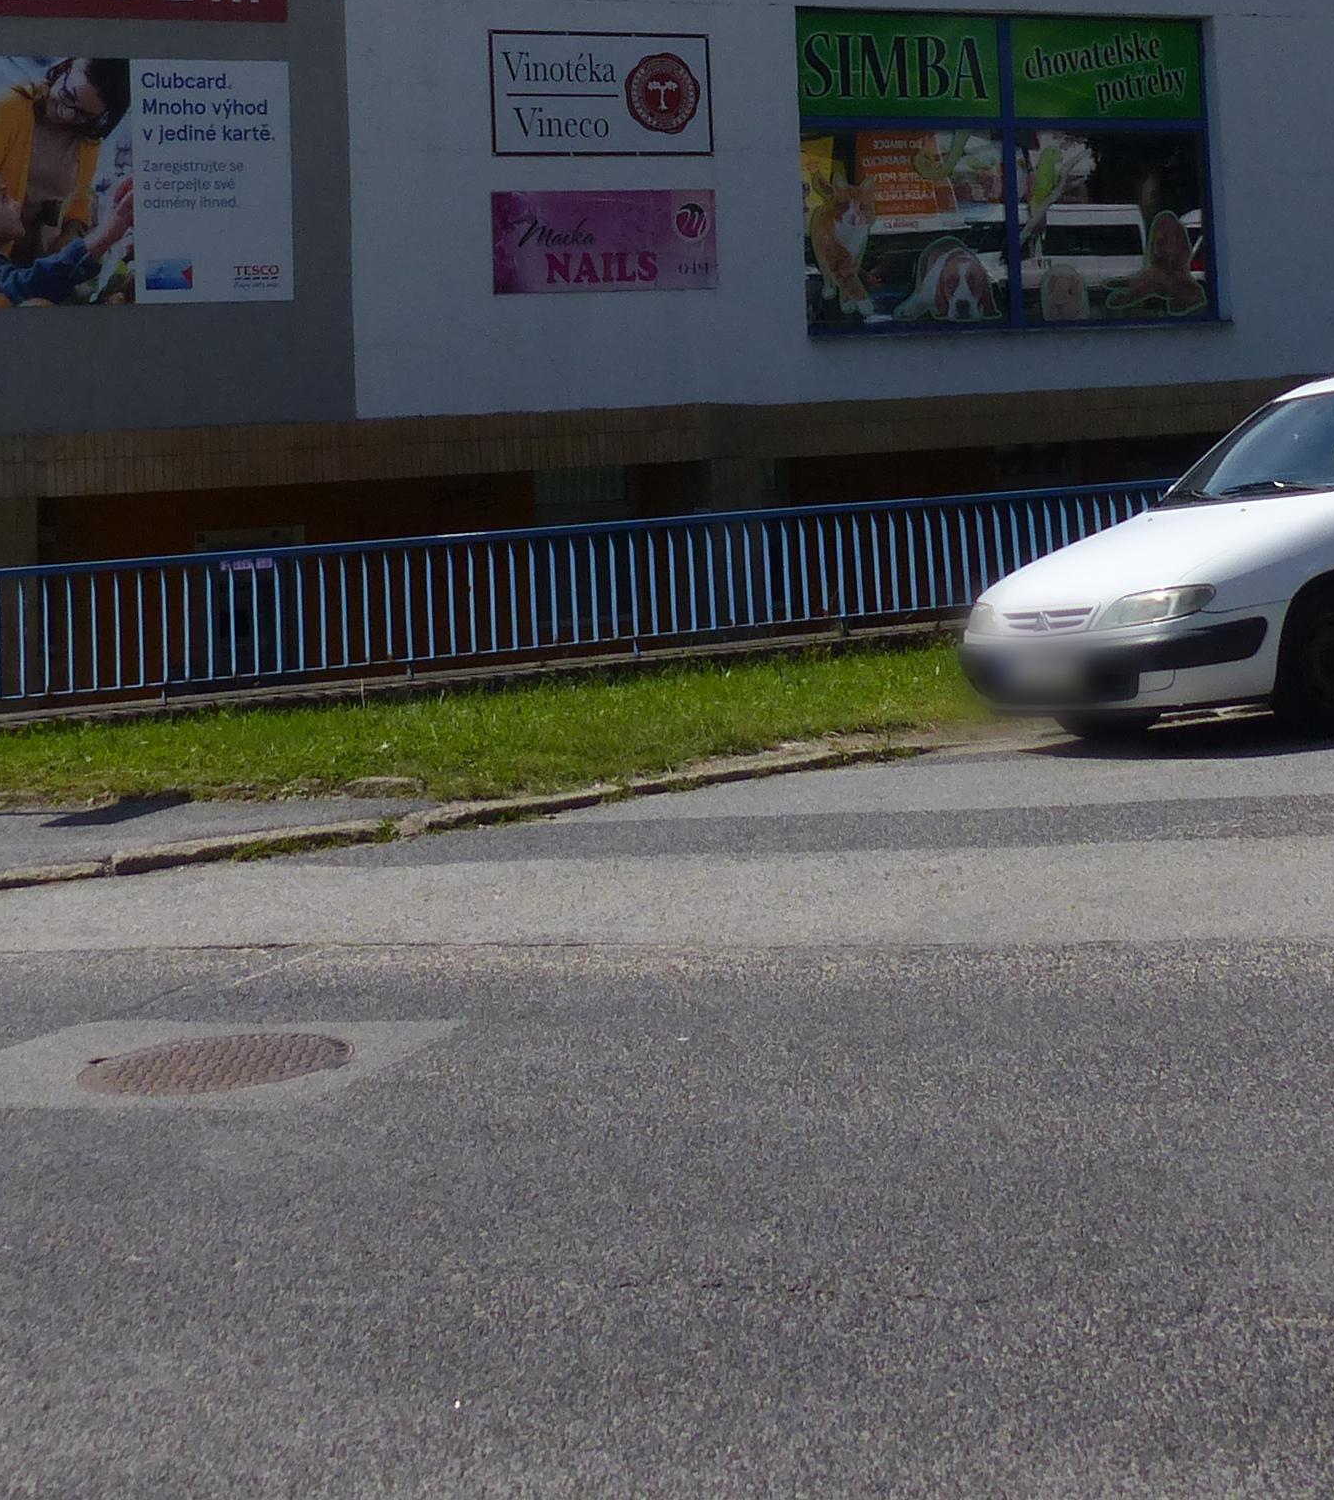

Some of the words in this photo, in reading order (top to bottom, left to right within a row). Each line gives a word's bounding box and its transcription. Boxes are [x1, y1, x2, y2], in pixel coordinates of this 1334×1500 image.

[502, 51, 617, 83] Vinotéka
[803, 32, 989, 100] SIMBA
[1023, 30, 1162, 81] chovatelské
[1095, 63, 1186, 113] potřeby
[142, 97, 206, 116] Mnoho
[213, 97, 268, 120] výhod
[513, 106, 610, 138] Vineco
[143, 127, 153, 141] v
[158, 124, 216, 145] jediné
[229, 161, 244, 173] se
[142, 180, 151, 191] a
[233, 264, 280, 276] TESCO
[545, 251, 660, 284] NAILS
